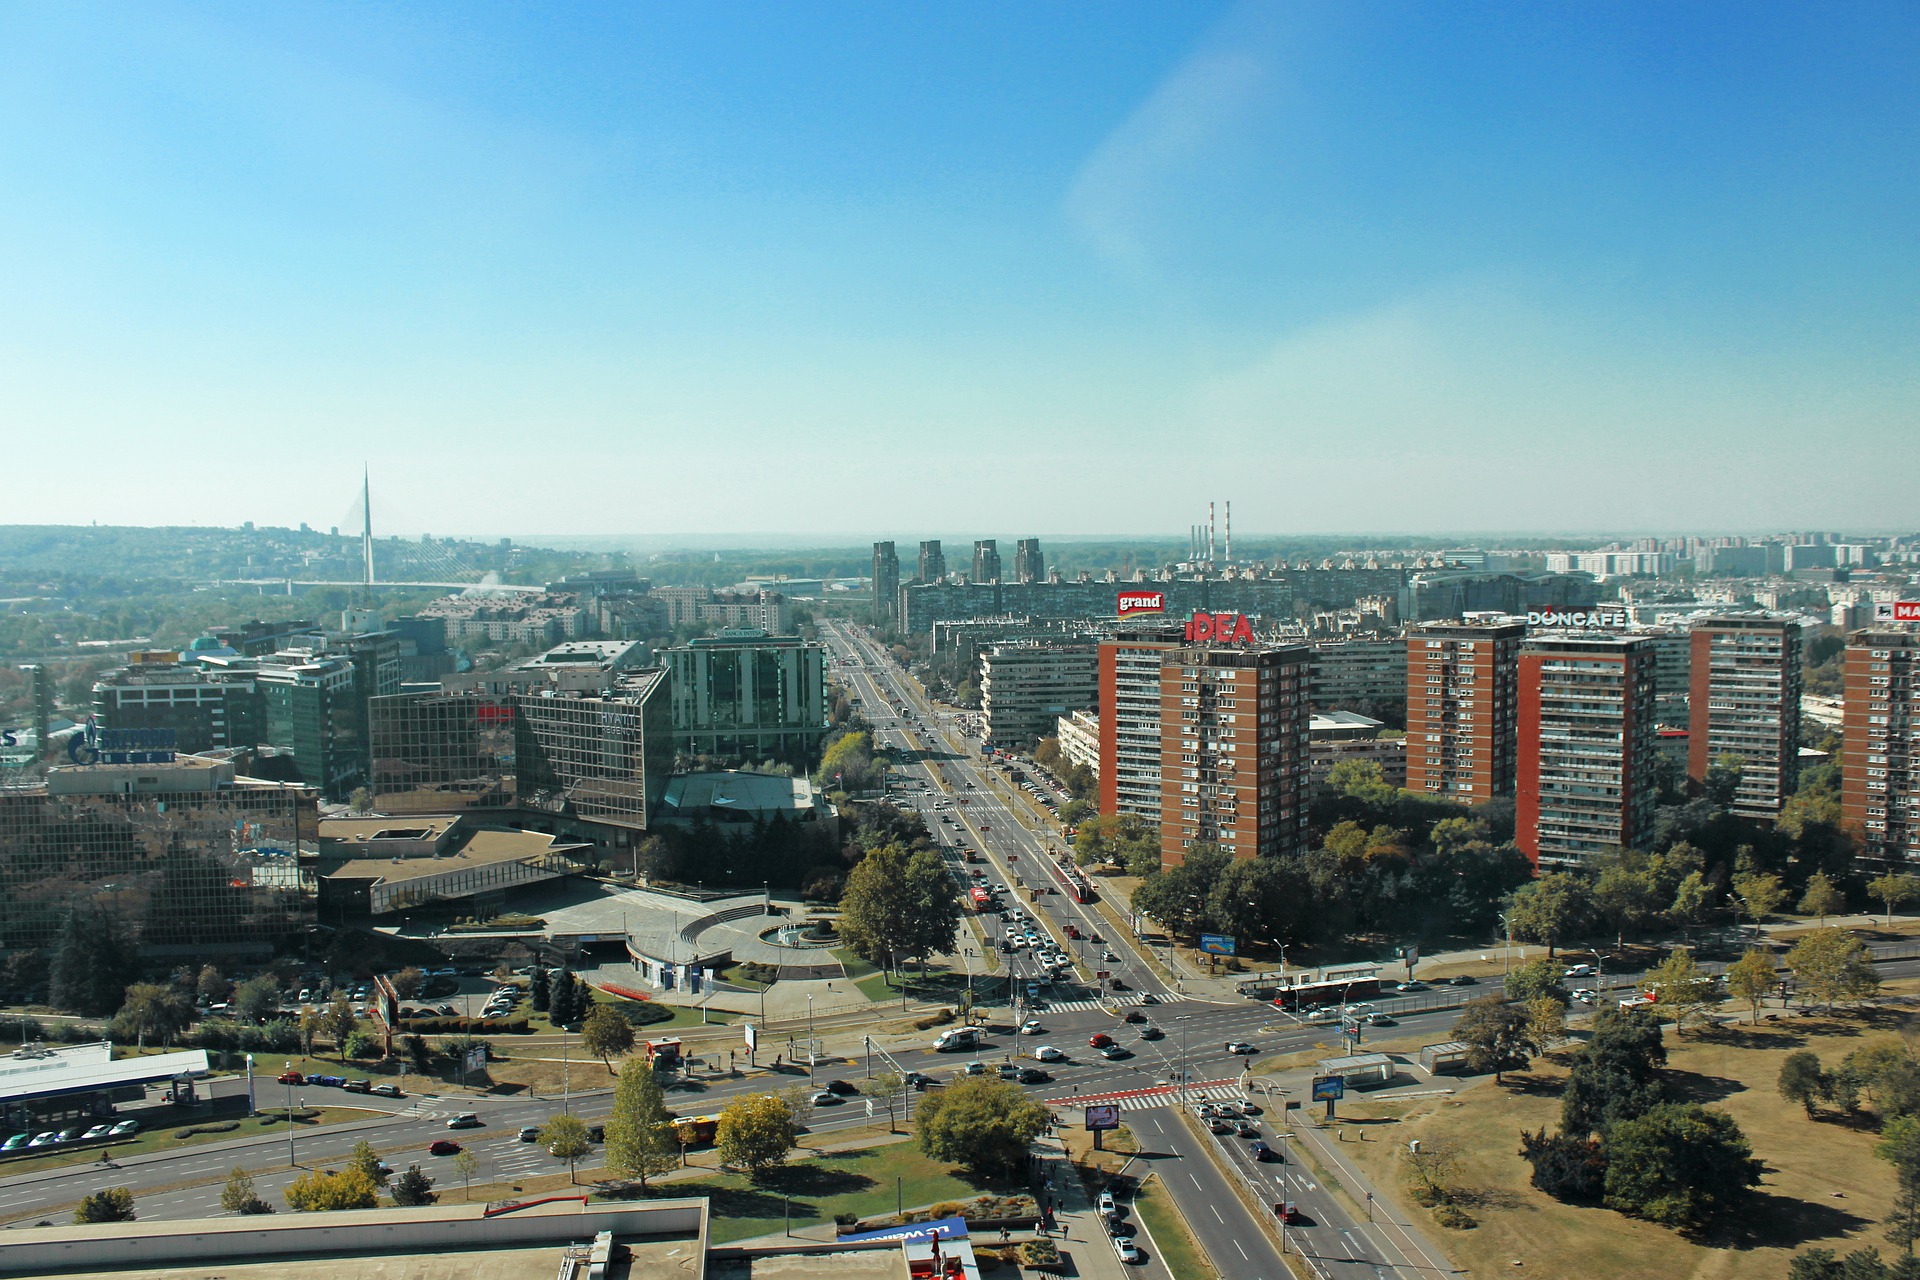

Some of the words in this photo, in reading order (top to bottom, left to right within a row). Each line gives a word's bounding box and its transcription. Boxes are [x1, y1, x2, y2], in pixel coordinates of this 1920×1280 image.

[1119, 594, 1162, 611] grand
[602, 712, 635, 726] HYATT
[602, 726, 635, 736] REGENCY
[104, 753, 174, 764] NEFT
[925, 1225, 950, 1235] LC
